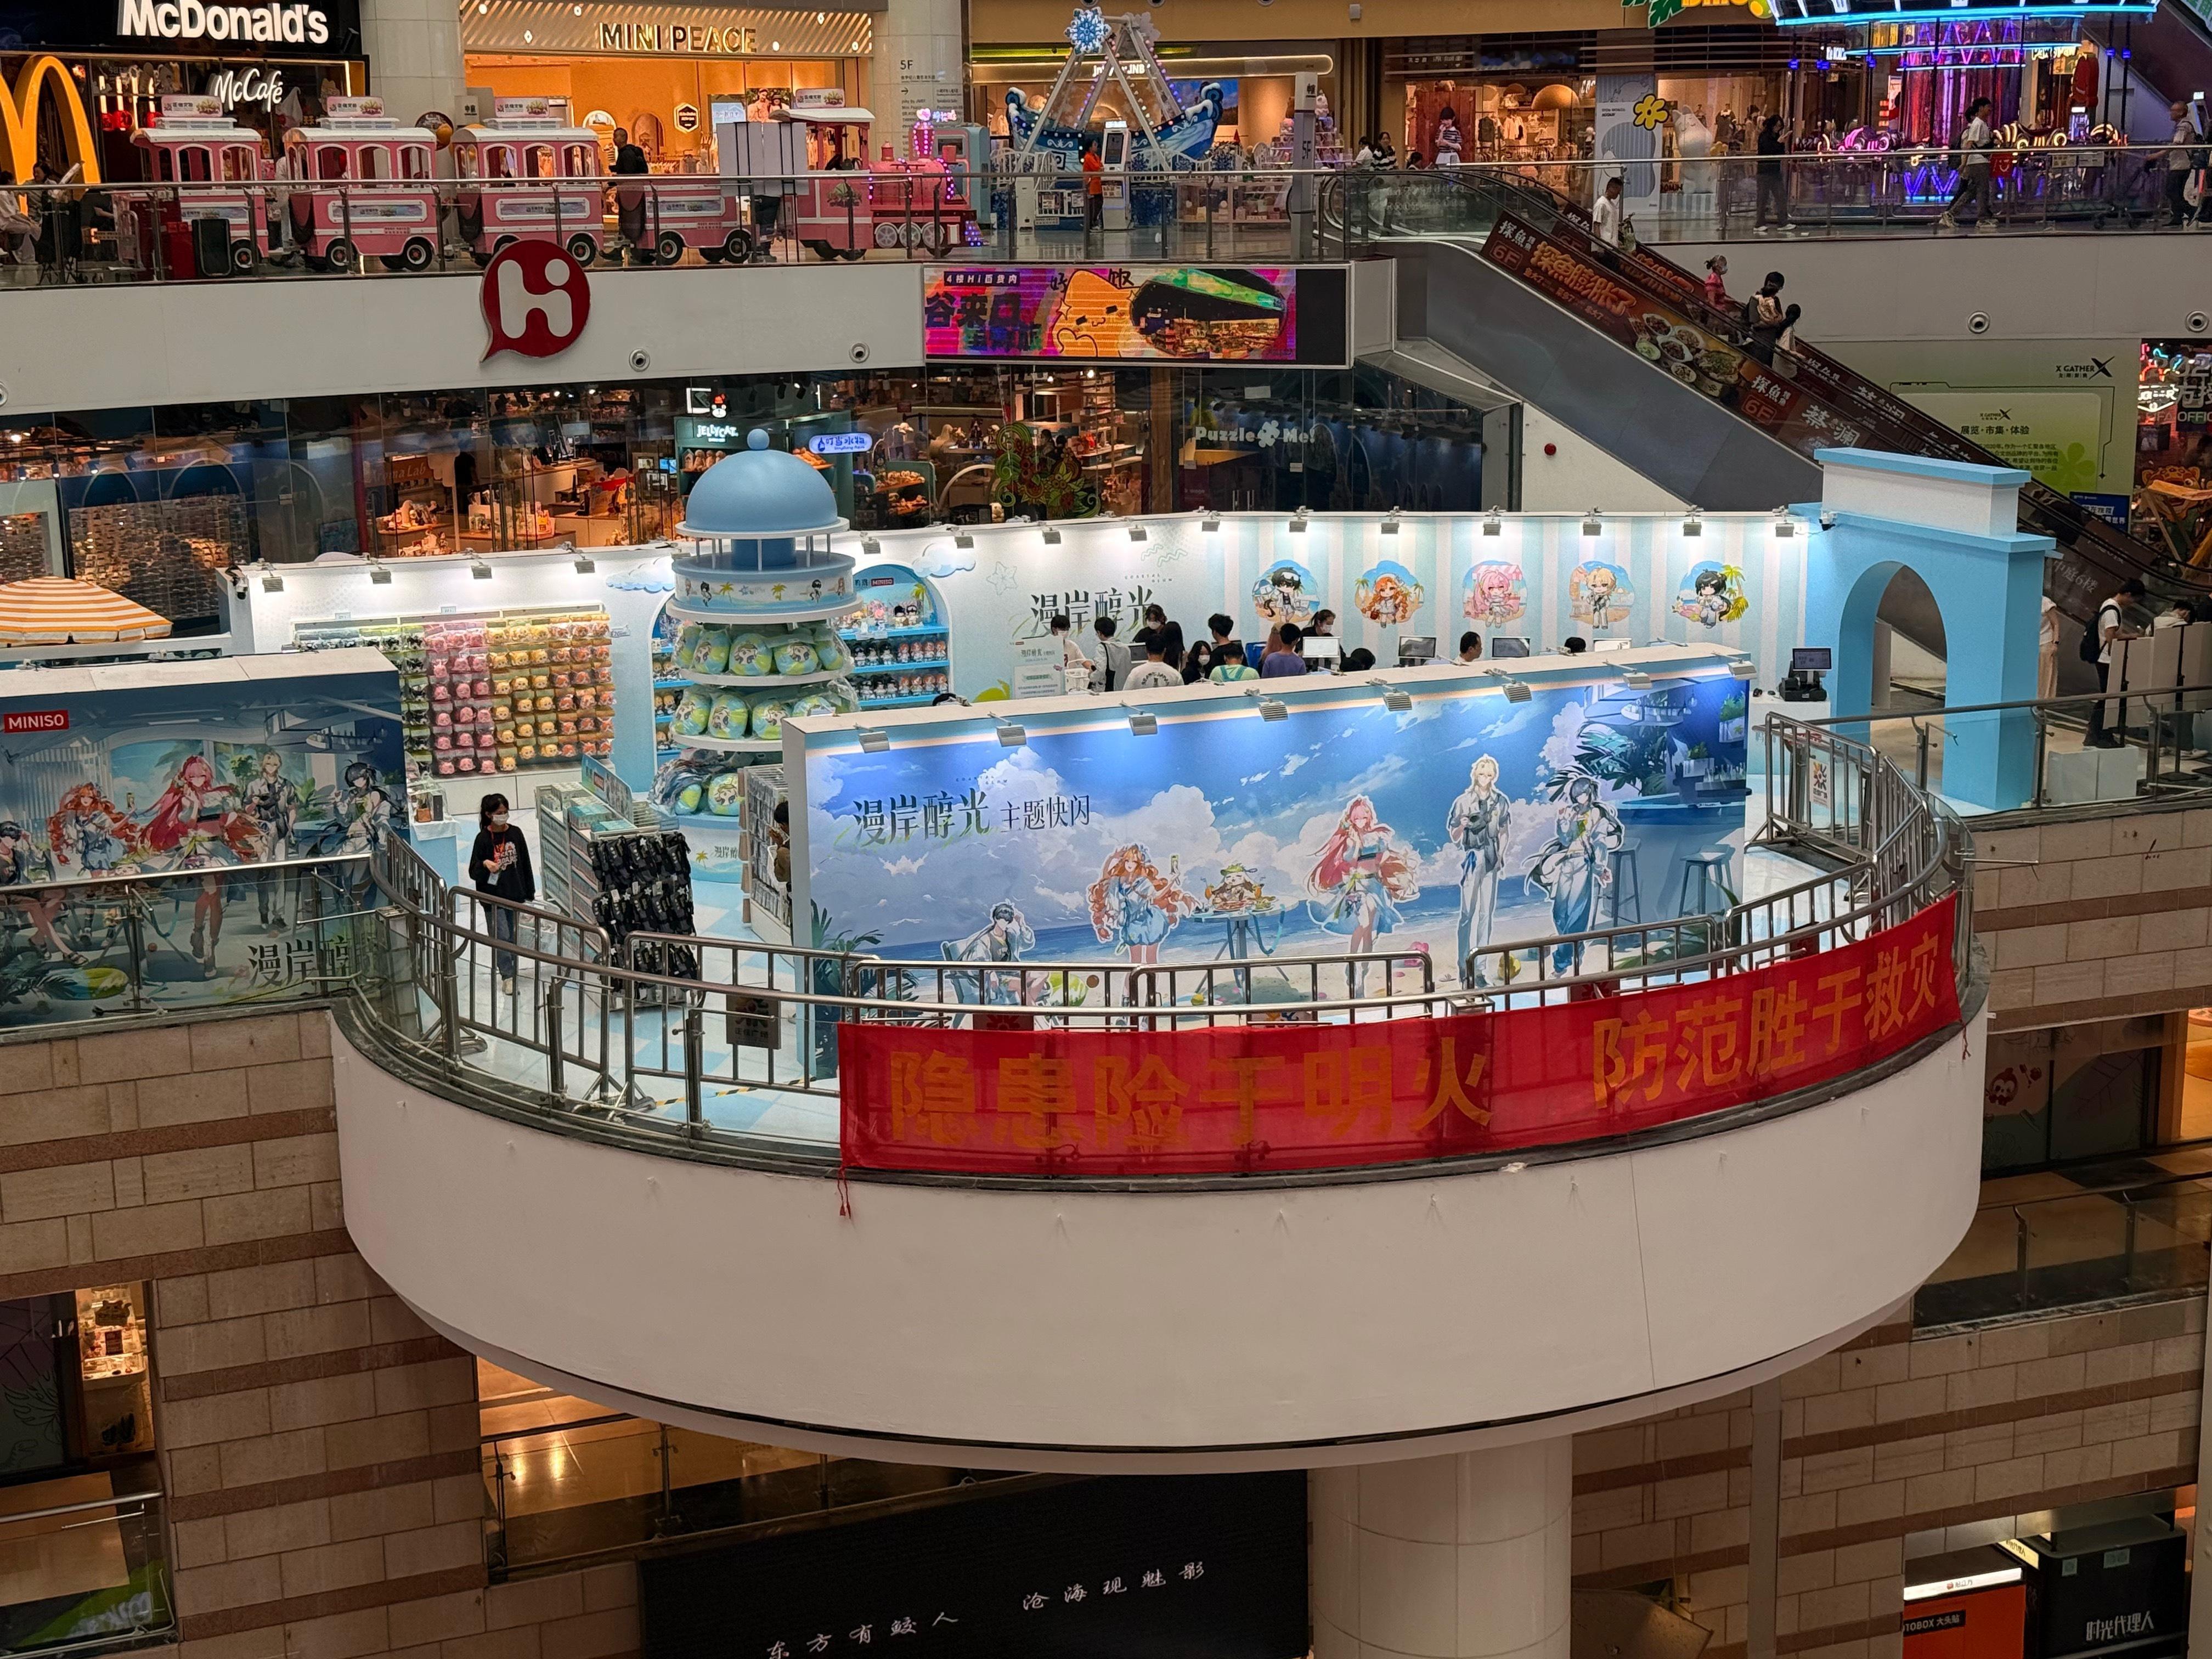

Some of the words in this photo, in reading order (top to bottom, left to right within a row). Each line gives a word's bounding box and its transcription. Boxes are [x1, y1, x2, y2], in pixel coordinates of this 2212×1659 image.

[120, 0, 329, 44] McDonald's
[599, 22, 661, 51] MINI
[669, 24, 758, 54] PEACE
[900, 59, 913, 70] 5F
[215, 68, 283, 112] McCafé
[1493, 245, 1521, 264] 6F
[1743, 400, 1774, 422] 6F
[1195, 426, 1256, 442] Puzzle
[1283, 427, 1316, 444] Me!
[407, 461, 426, 477] Lab
[2053, 559, 2098, 593] 中庭6楼
[8, 713, 65, 730] MINISO
[853, 787, 990, 847] 漫岸醇光
[1000, 794, 1090, 833] 主题快闪
[889, 1036, 1494, 1147] 隐患险于明火
[1593, 931, 1939, 1109] 防范胜于救灾
[1023, 1561, 1205, 1610] 沧海现魅影
[767, 1611, 959, 1659] 东方有鲛人
[2086, 1611, 2154, 1641] 时光代理人
